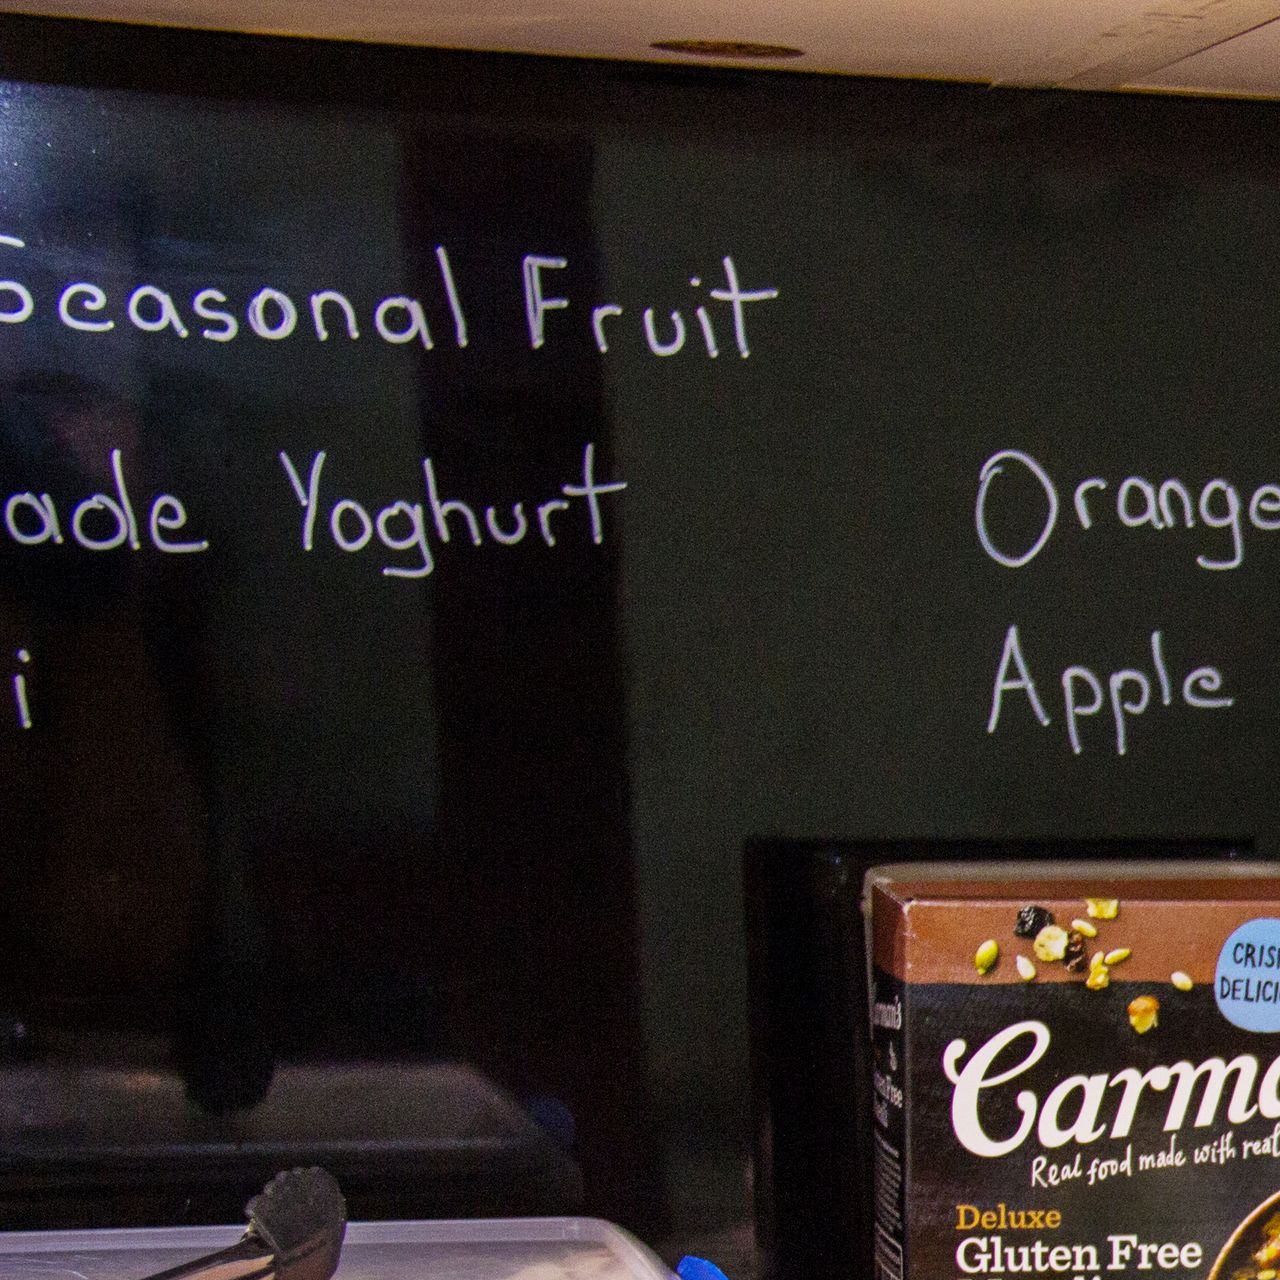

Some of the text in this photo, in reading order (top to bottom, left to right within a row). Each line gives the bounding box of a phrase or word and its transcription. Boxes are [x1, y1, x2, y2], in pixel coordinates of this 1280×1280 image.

[522, 255, 780, 359] Fruit
[279, 443, 629, 578] Yoghurt
[987, 624, 1235, 756] Apple
[1031, 1150, 1082, 1188] Real
[1086, 1147, 1133, 1186] food
[1138, 1134, 1186, 1171] made
[1193, 1131, 1236, 1166] with
[955, 1203, 1062, 1231] Deluxe
[955, 1234, 1202, 1273] Gluten Free
